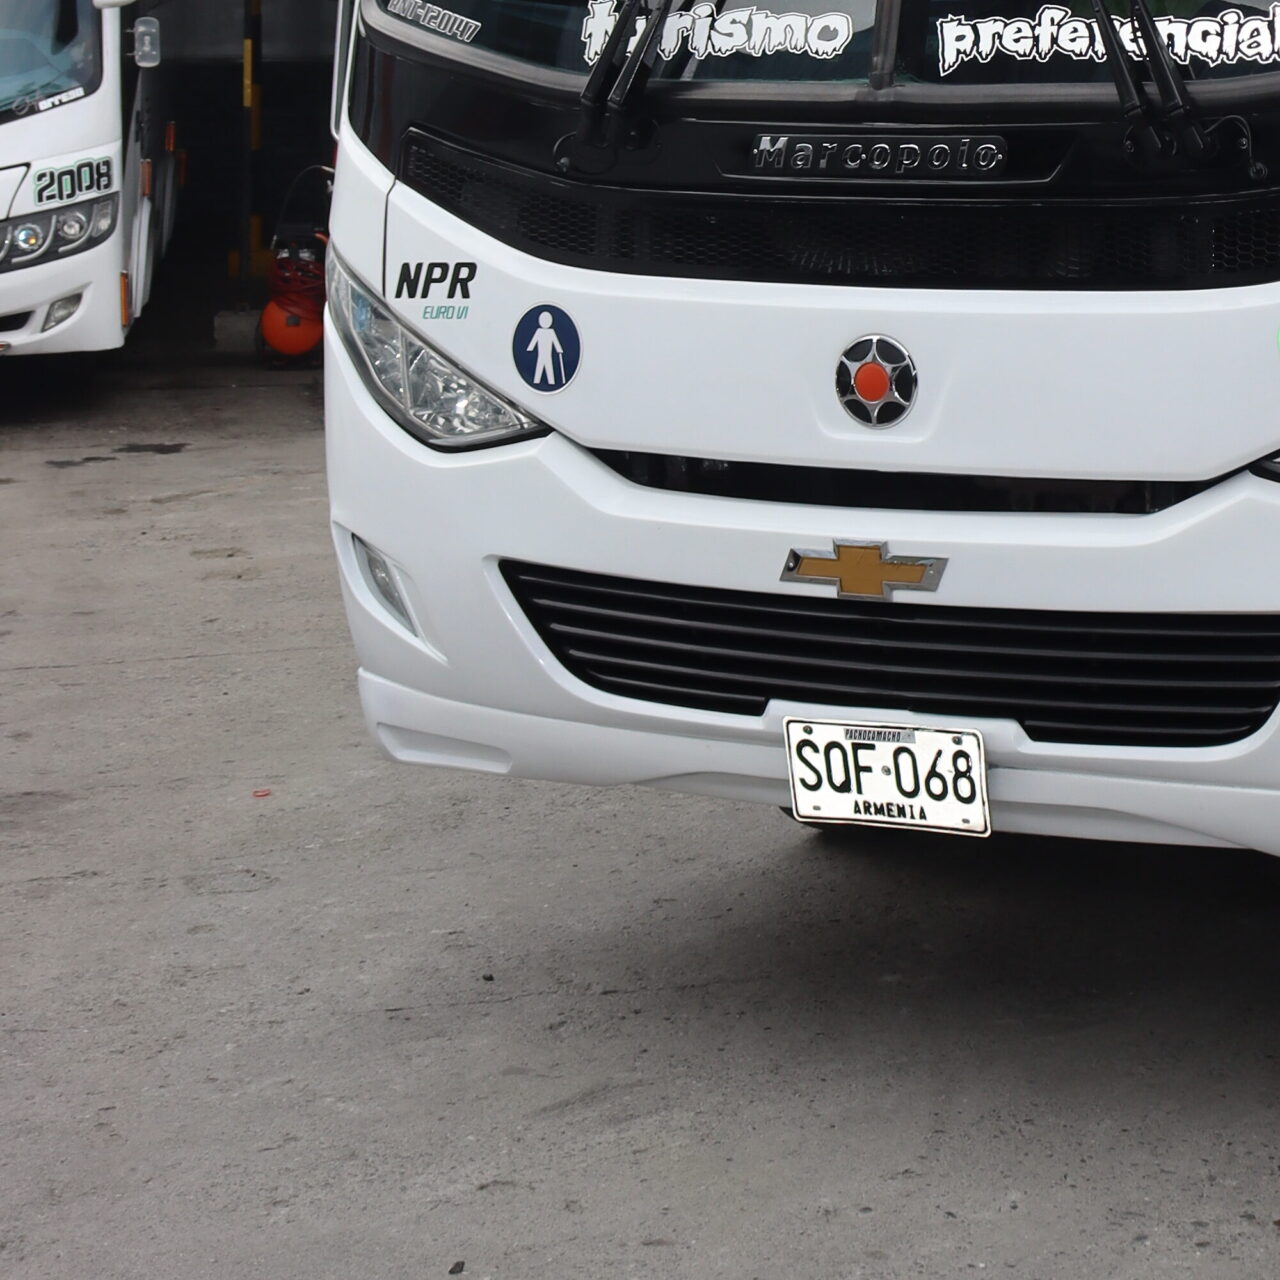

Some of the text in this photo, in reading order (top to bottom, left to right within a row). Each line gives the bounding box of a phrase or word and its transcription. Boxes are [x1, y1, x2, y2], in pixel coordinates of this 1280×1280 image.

[755, 136, 998, 174] Marcopolo
[36, 159, 113, 204] 2008
[395, 262, 478, 300] NPR
[422, 306, 455, 320] EURO
[853, 800, 927, 820] ARMENIA
